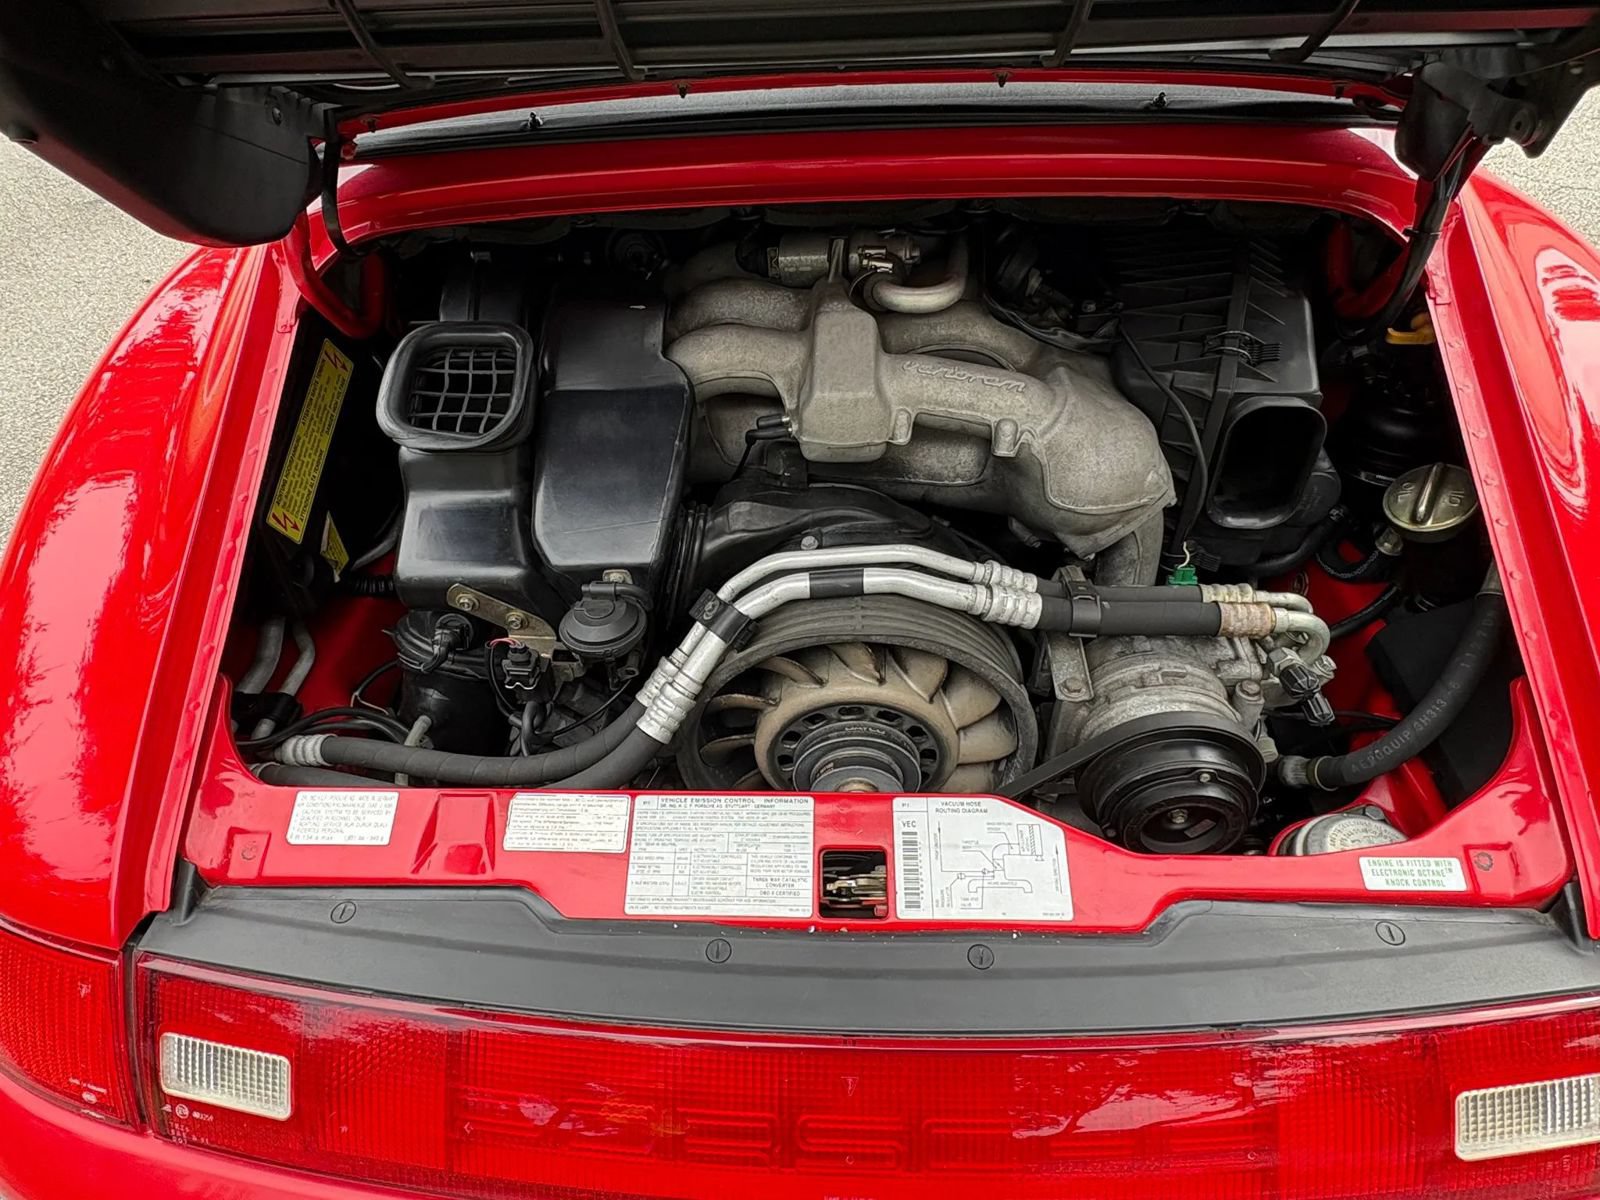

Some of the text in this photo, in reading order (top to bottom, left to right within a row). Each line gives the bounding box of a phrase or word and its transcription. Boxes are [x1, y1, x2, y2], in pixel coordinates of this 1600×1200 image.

[1368, 859, 1394, 867] ENGINE
[1371, 869, 1415, 877] ELECTRONIC
[1385, 878, 1446, 888] KNOCK CONTROL
